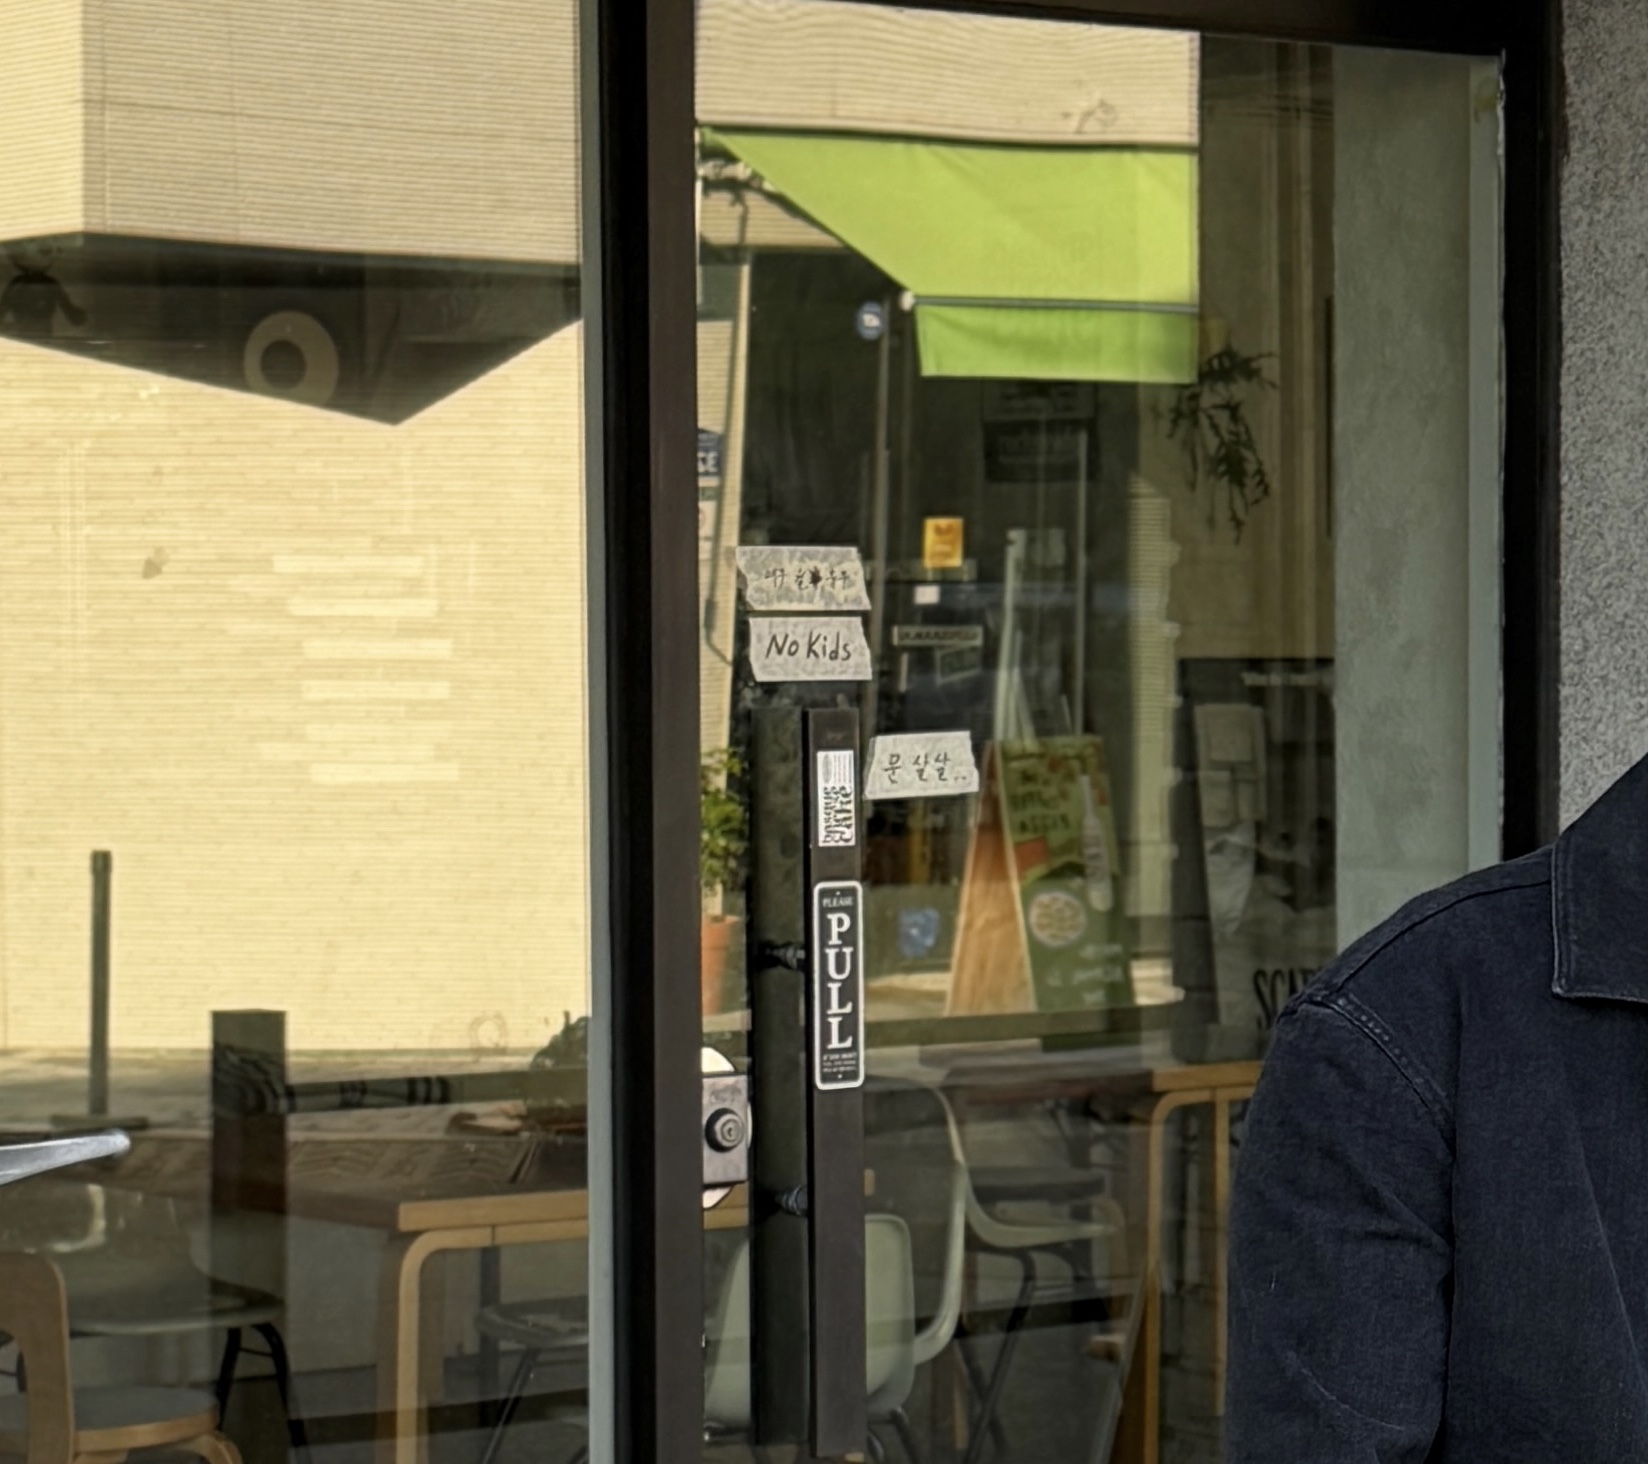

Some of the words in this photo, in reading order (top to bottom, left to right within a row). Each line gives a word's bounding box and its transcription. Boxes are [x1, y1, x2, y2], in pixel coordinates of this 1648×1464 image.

[765, 633, 799, 659] No
[806, 629, 851, 661] Kids
[882, 753, 902, 784] 문
[825, 912, 854, 1050] PULL
